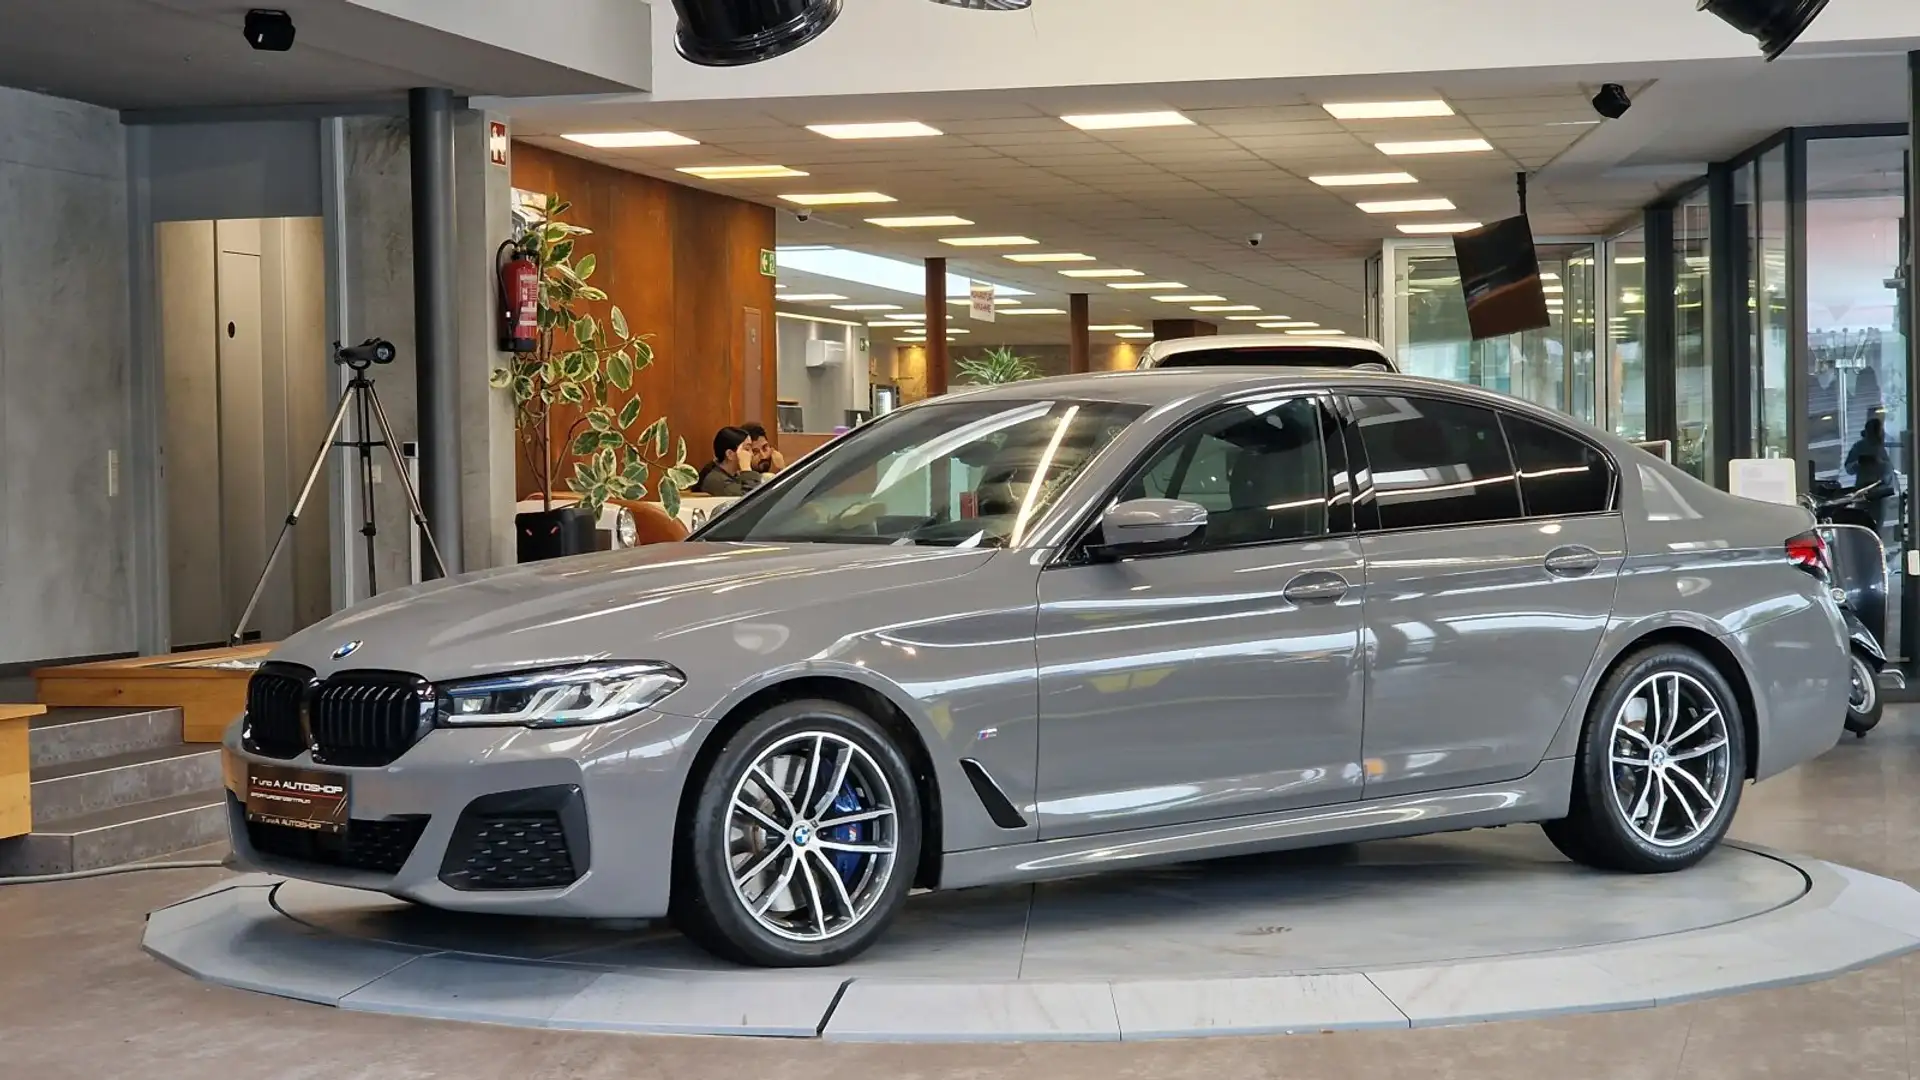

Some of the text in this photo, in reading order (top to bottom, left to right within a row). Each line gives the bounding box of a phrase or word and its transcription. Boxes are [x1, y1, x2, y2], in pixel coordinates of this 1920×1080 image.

[251, 776, 258, 784] T
[273, 780, 281, 788] A
[282, 781, 343, 794] AUTOSHOP
[280, 819, 322, 830] AUTOSHOP
